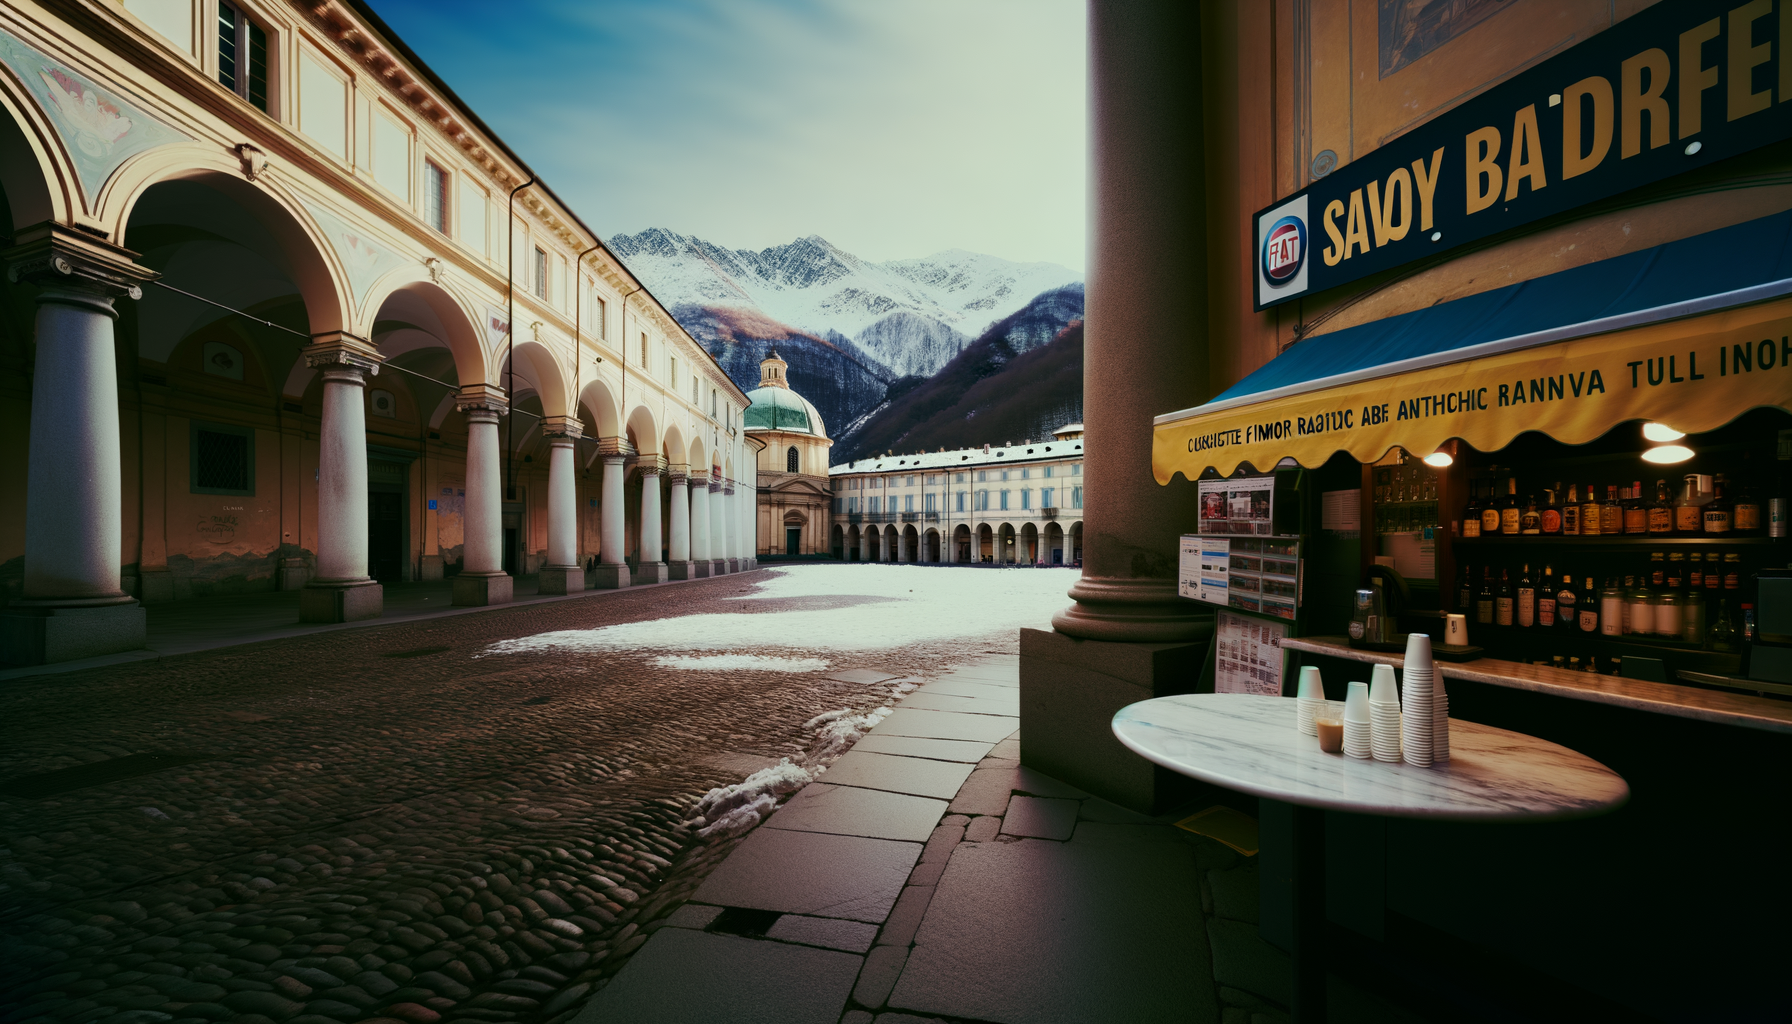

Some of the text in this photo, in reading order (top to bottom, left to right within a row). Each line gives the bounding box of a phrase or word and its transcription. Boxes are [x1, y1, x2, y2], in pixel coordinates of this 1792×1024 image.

[1323, 146, 1445, 267] SAVOY
[1498, 369, 1606, 407] RANNVA
[1627, 351, 1705, 388] TULL
